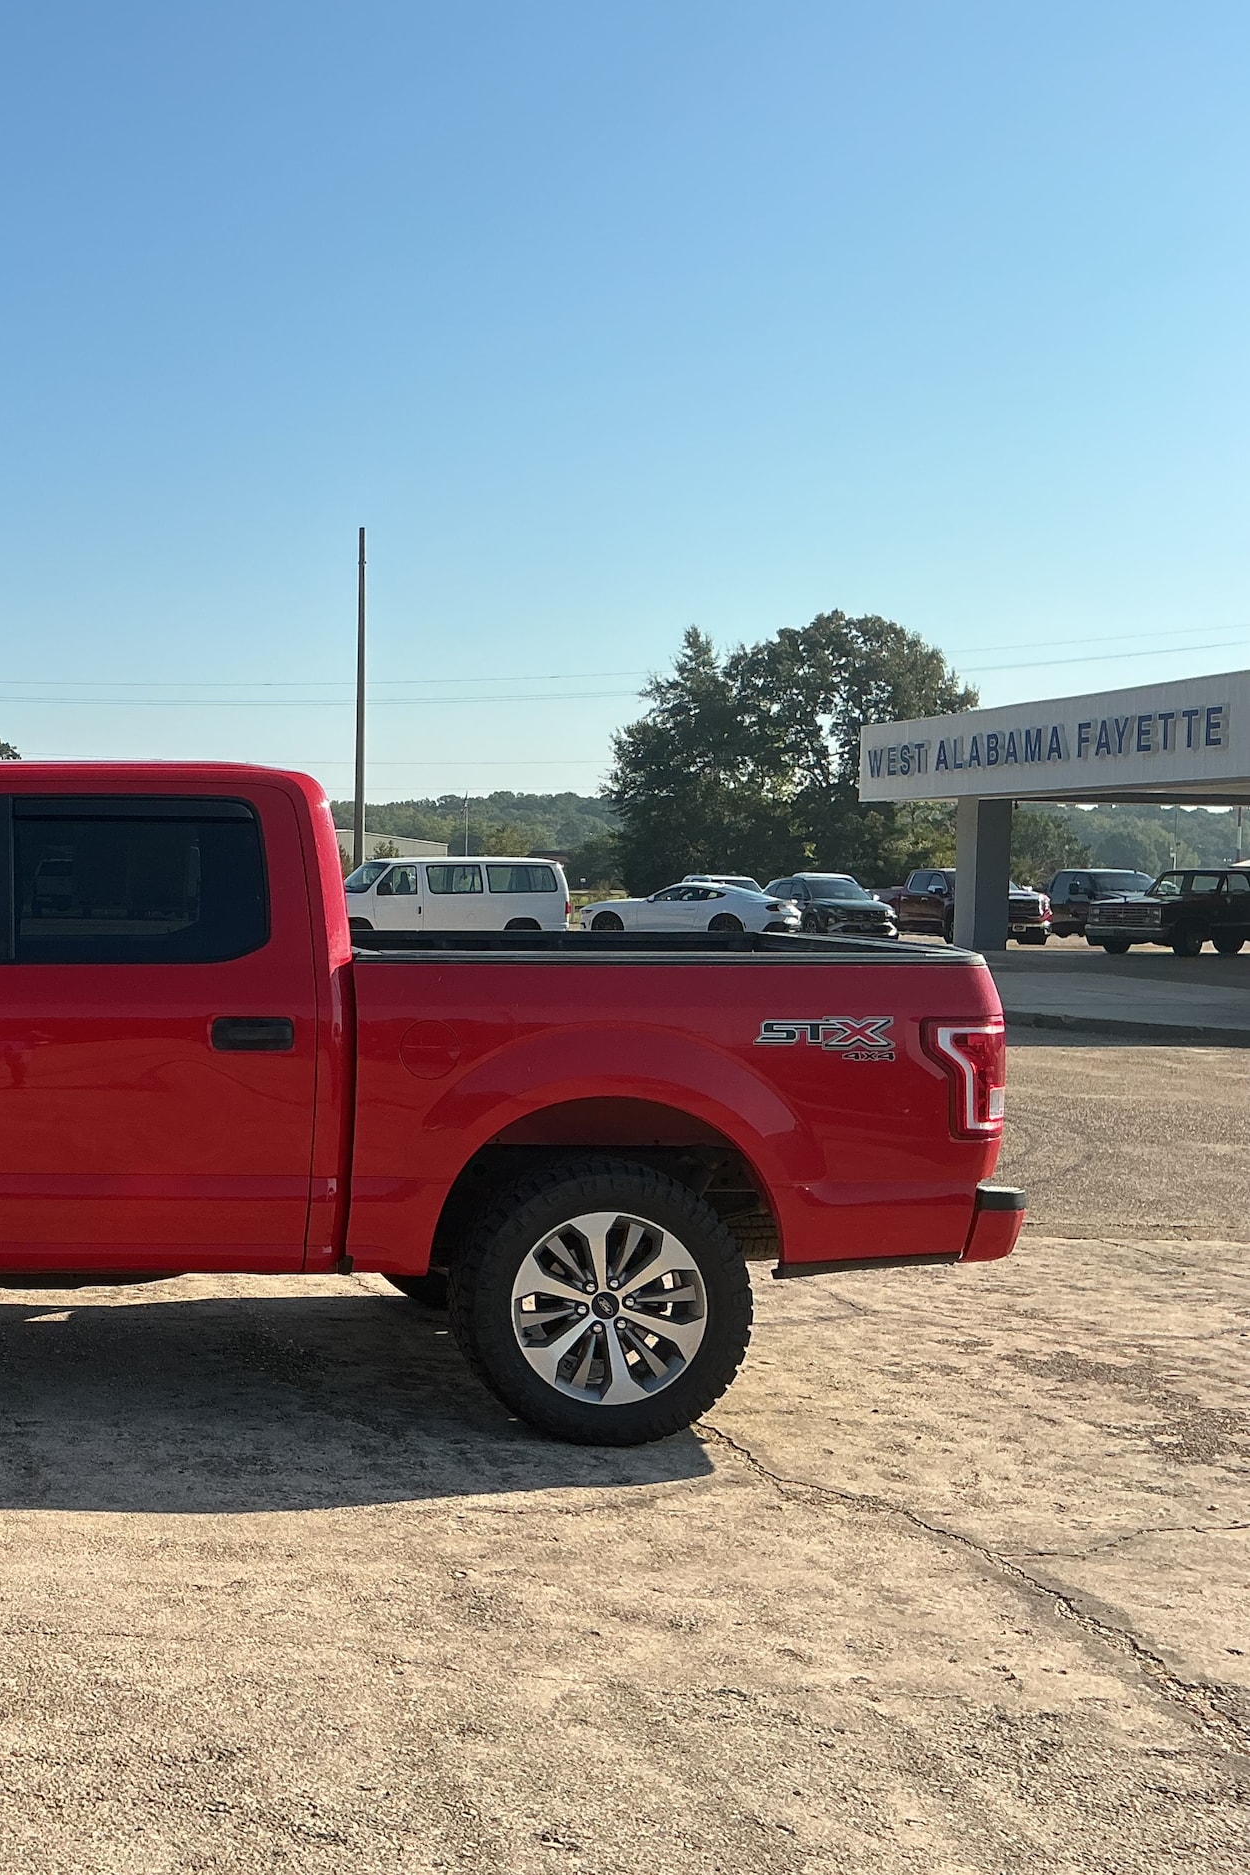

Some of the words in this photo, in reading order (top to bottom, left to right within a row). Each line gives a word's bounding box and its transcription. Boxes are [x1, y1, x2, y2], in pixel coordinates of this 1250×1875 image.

[867, 743, 927, 779] WEST
[935, 725, 1063, 772] ALABAMA
[1076, 706, 1225, 758] FAYETTE
[753, 1016, 896, 1050] STX
